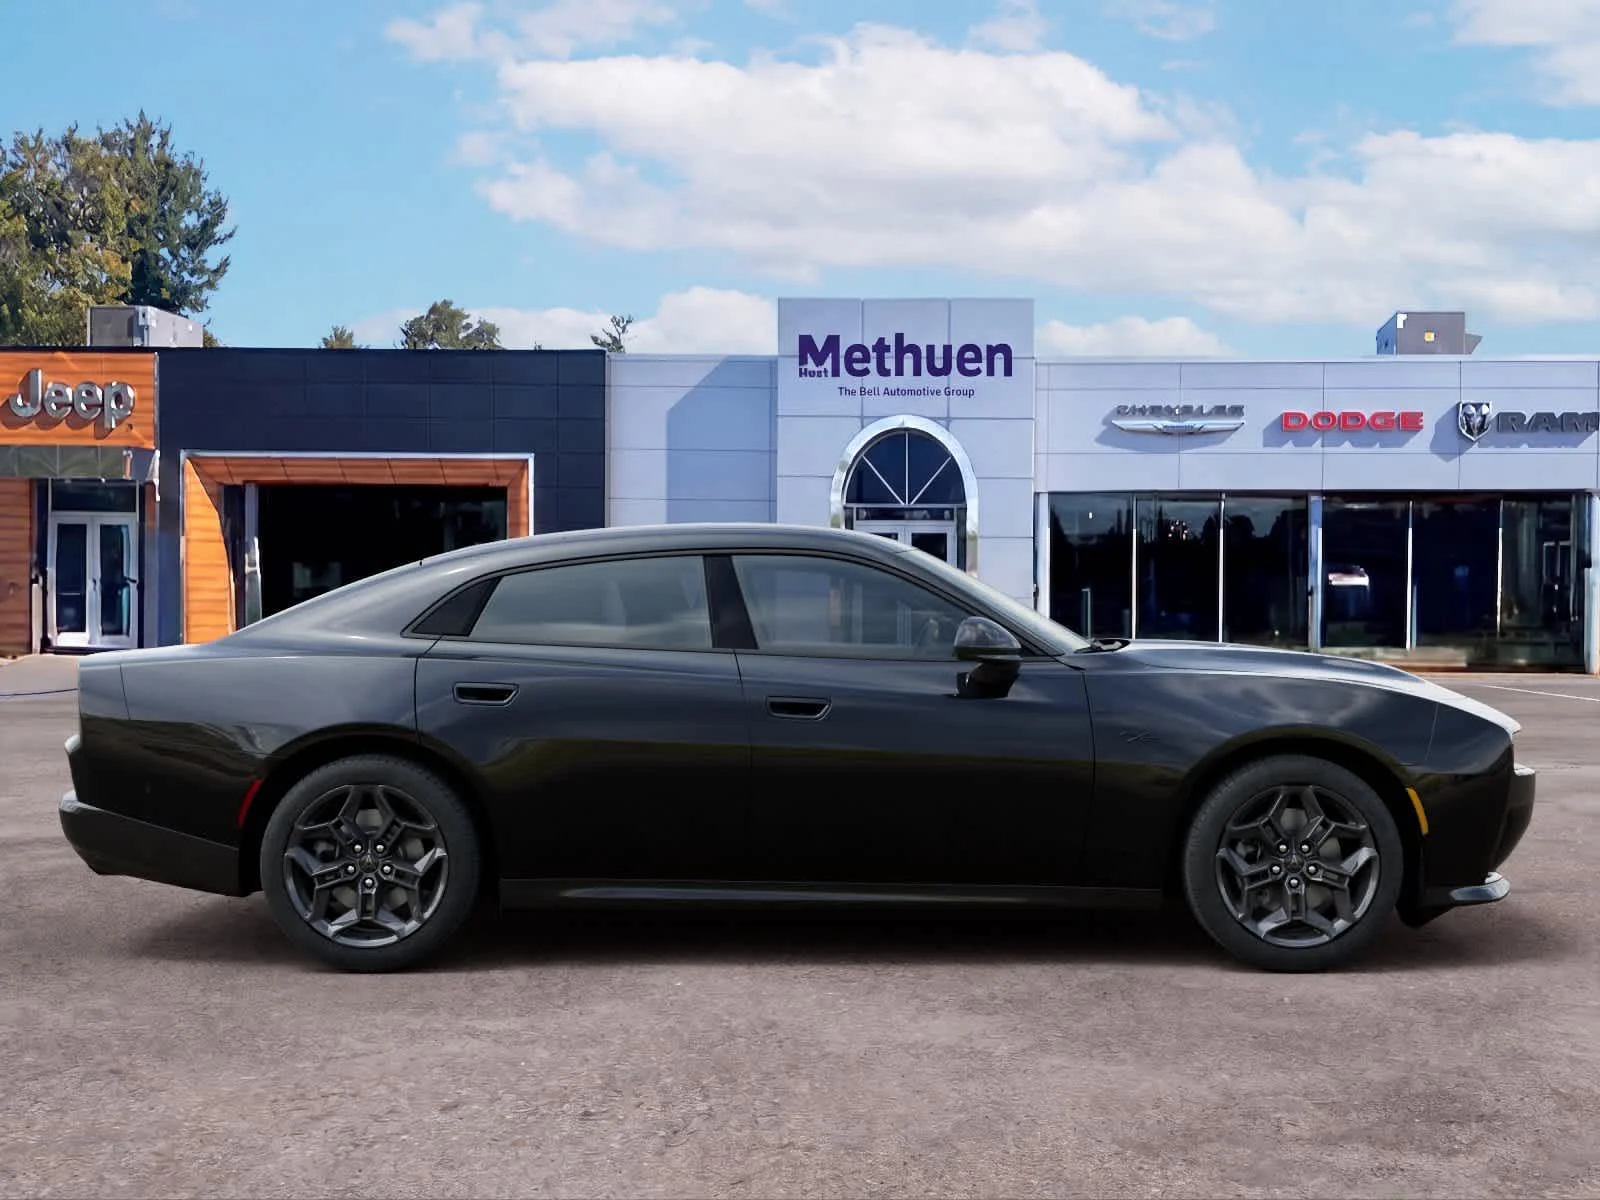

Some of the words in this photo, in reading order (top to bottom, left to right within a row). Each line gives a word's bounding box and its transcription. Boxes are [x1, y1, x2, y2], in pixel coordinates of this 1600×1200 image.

[798, 333, 1013, 378] Methuen
[9, 367, 136, 429] Jeep
[838, 386, 857, 397] The
[859, 386, 880, 397] Bell
[882, 385, 942, 397] Automotive
[943, 386, 976, 399] Group
[1282, 411, 1424, 431] DODGE
[1498, 412, 1600, 432] RAM
